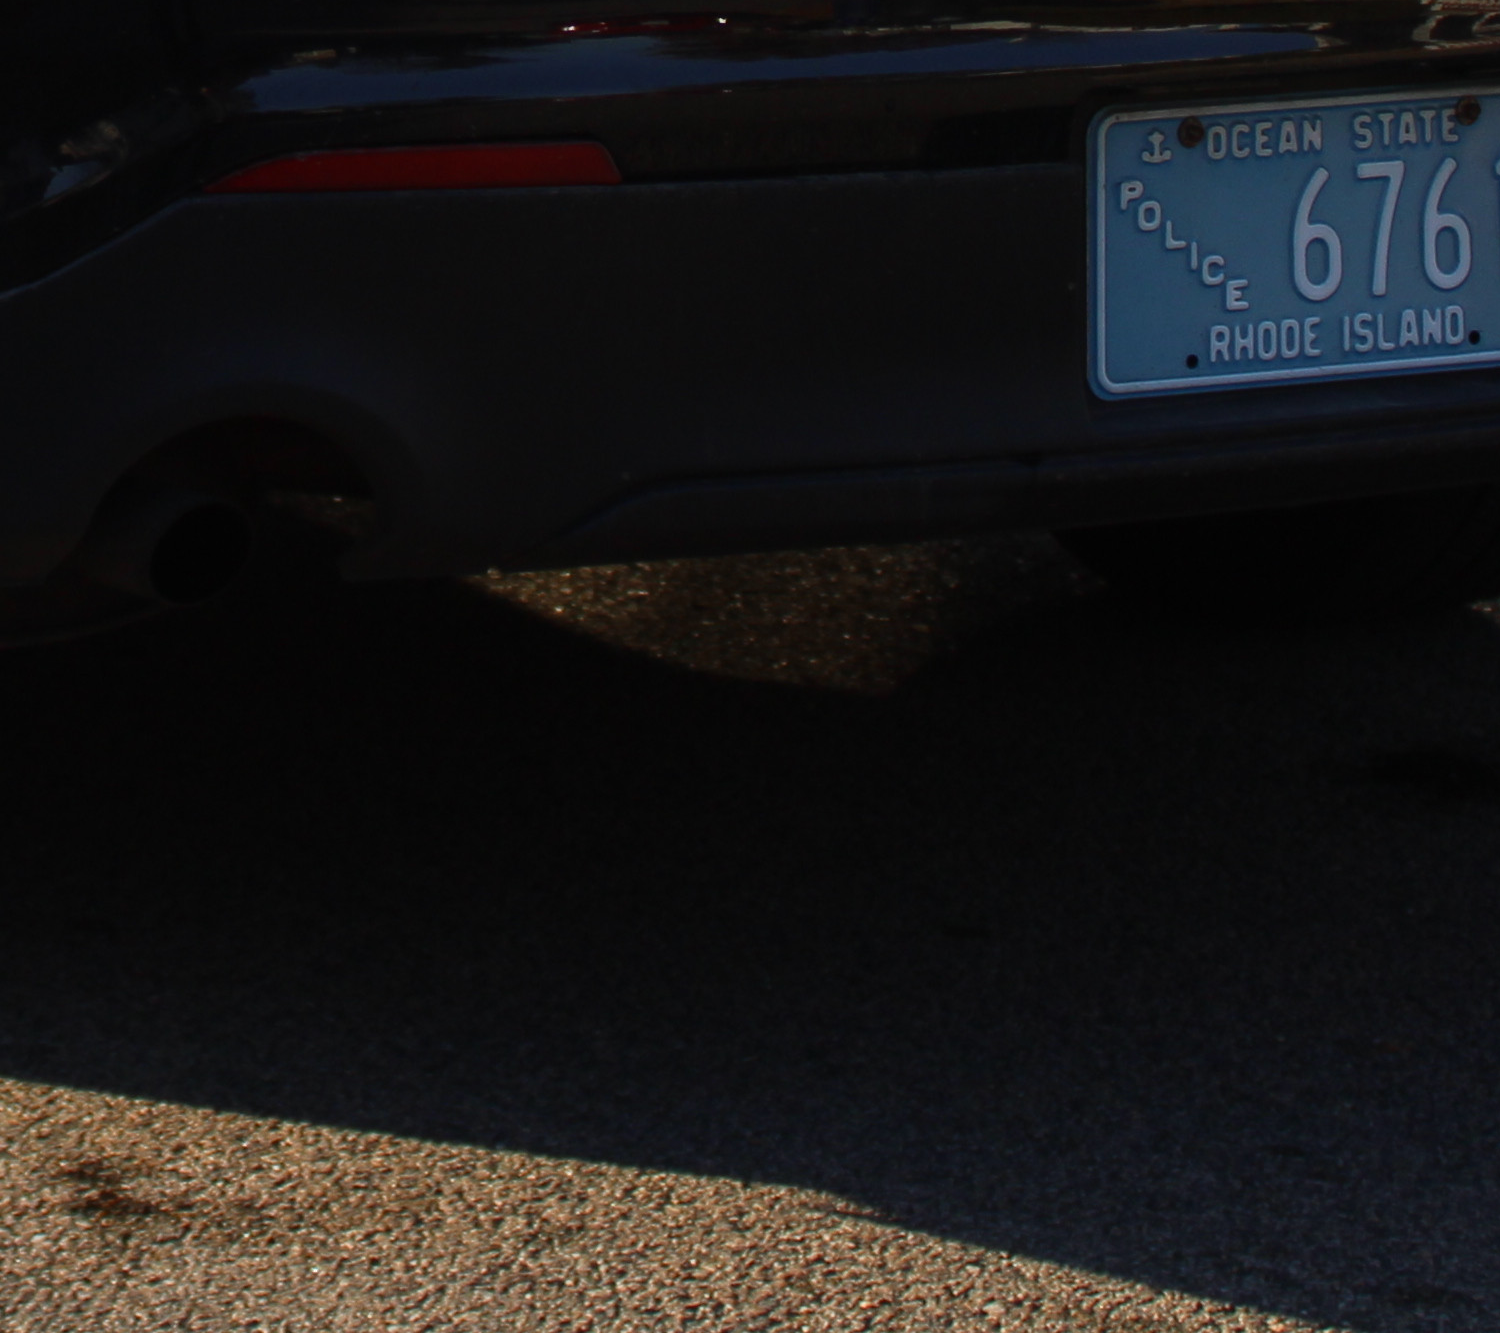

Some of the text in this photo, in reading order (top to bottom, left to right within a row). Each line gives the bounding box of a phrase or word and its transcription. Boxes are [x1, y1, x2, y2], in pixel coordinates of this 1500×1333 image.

[1205, 108, 1460, 160] OCEAN STATE
[1120, 180, 1249, 311] POLICE
[1209, 304, 1465, 363] RHODE ISLAND
